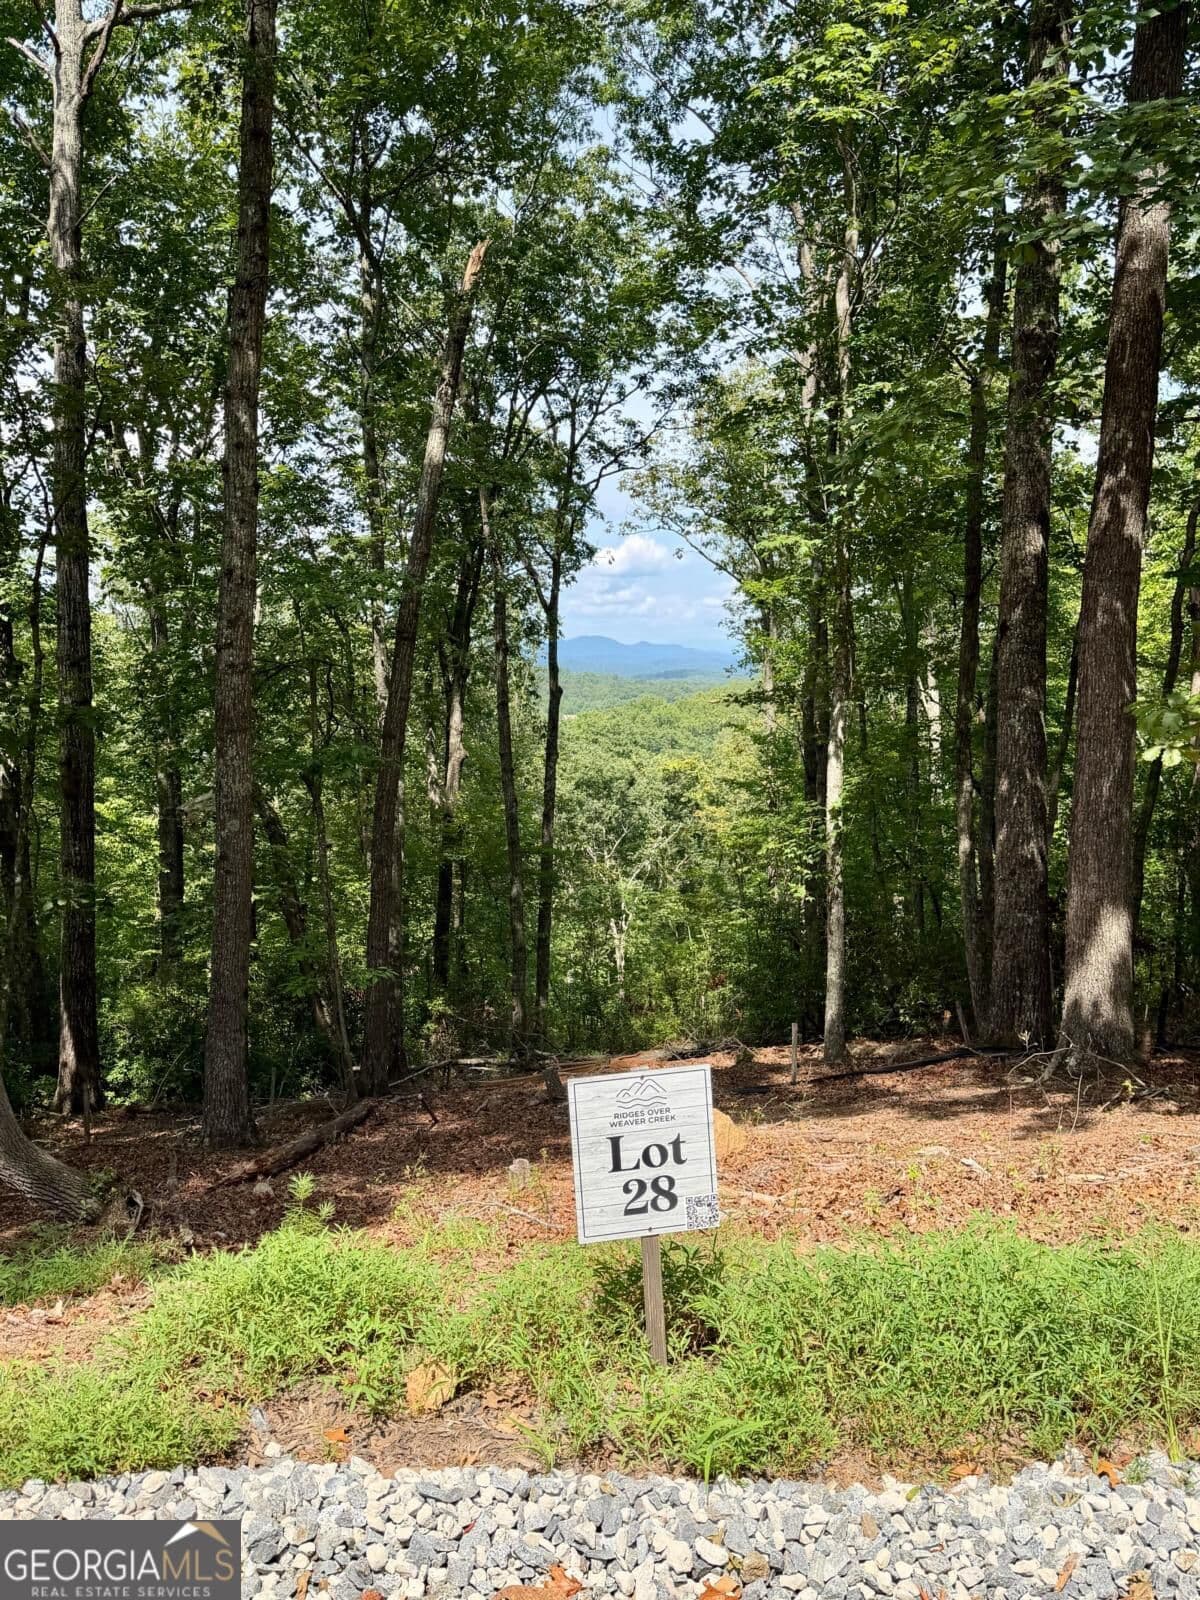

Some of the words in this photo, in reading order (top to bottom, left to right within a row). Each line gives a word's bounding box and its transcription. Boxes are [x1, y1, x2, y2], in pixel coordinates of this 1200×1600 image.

[609, 1118, 646, 1127] WEAVER
[648, 1114, 676, 1123] CREEK
[614, 1110, 645, 1119] RIDGES
[647, 1107, 671, 1116] OVER
[606, 1132, 687, 1173] Lot
[622, 1175, 678, 1216] 28
